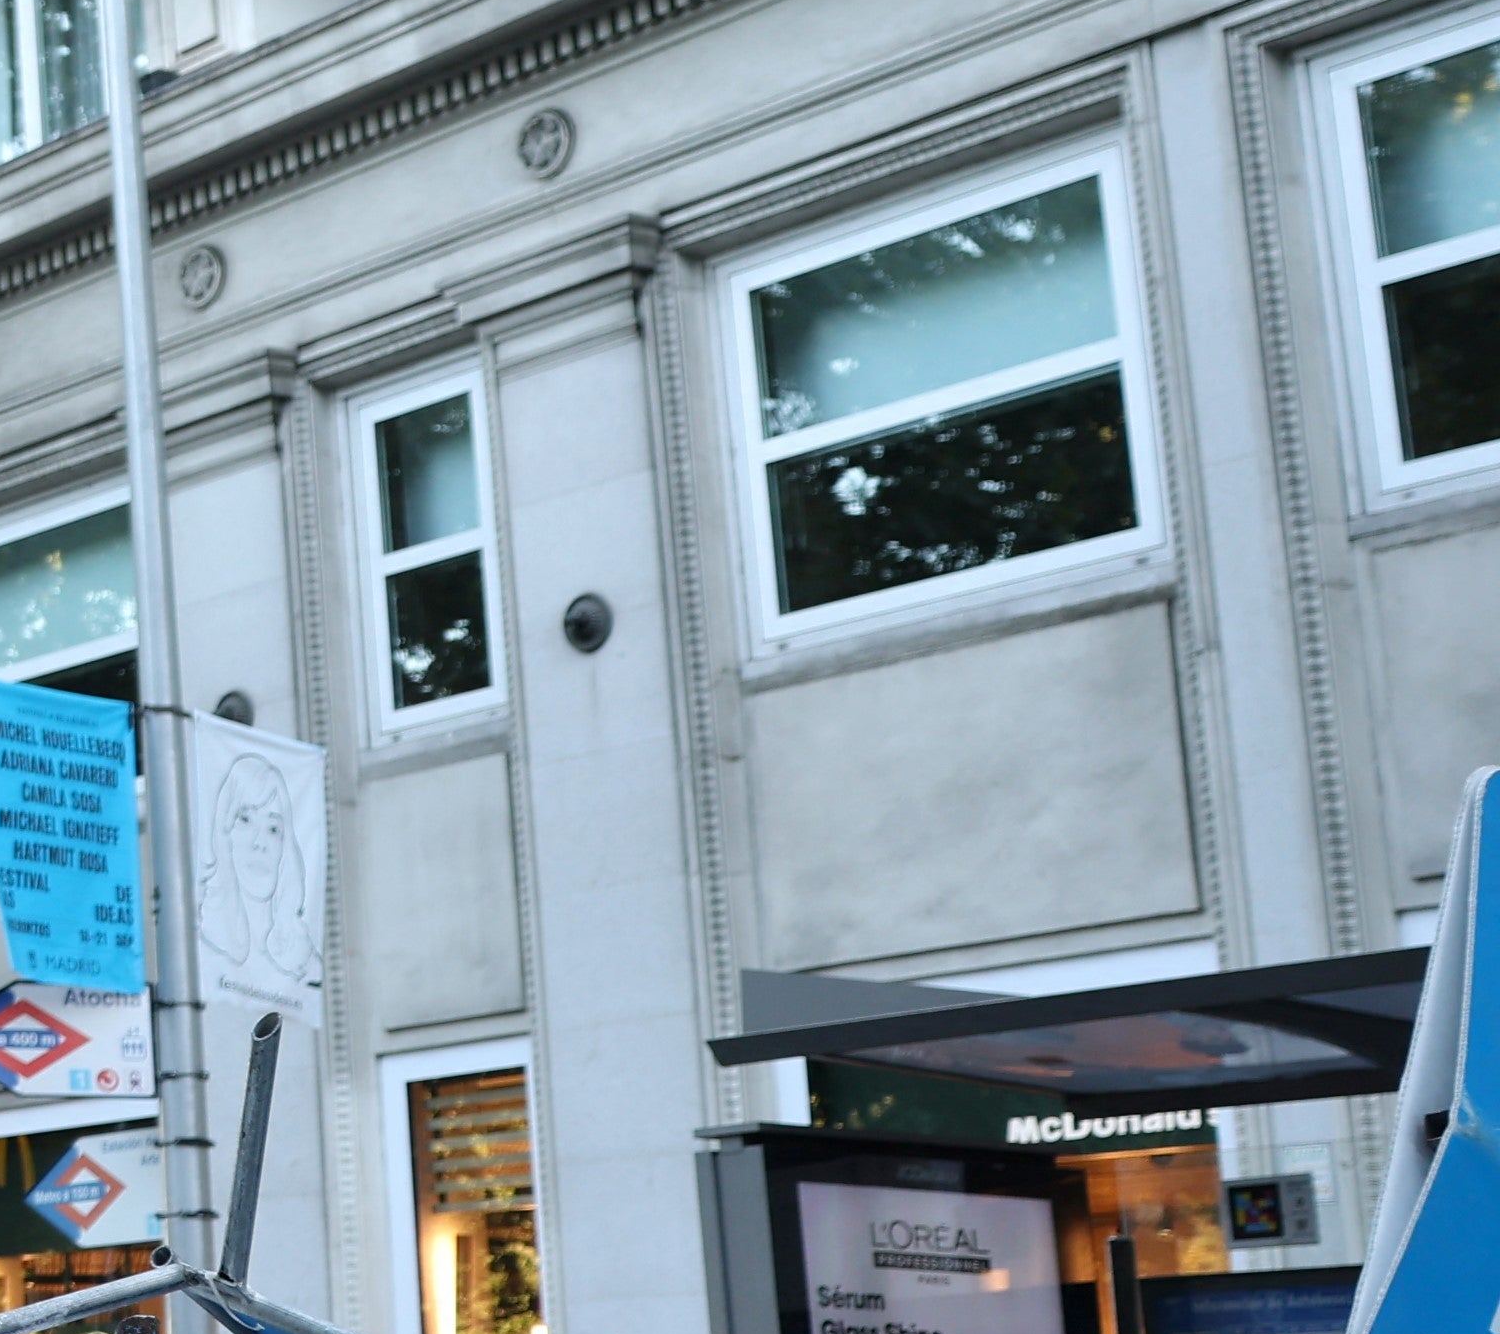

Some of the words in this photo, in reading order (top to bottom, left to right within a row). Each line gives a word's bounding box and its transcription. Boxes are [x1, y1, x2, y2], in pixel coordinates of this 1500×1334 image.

[0, 749, 55, 777] ADRIANA
[22, 782, 67, 807] CAMILA
[0, 809, 58, 836] MICHAEL
[13, 840, 75, 868] HARTMUT
[95, 904, 133, 925] IDEAS
[1006, 1108, 1222, 1145] McDonalds
[870, 1220, 991, 1255] L'ORÉAL
[817, 1284, 886, 1311] Sérum
